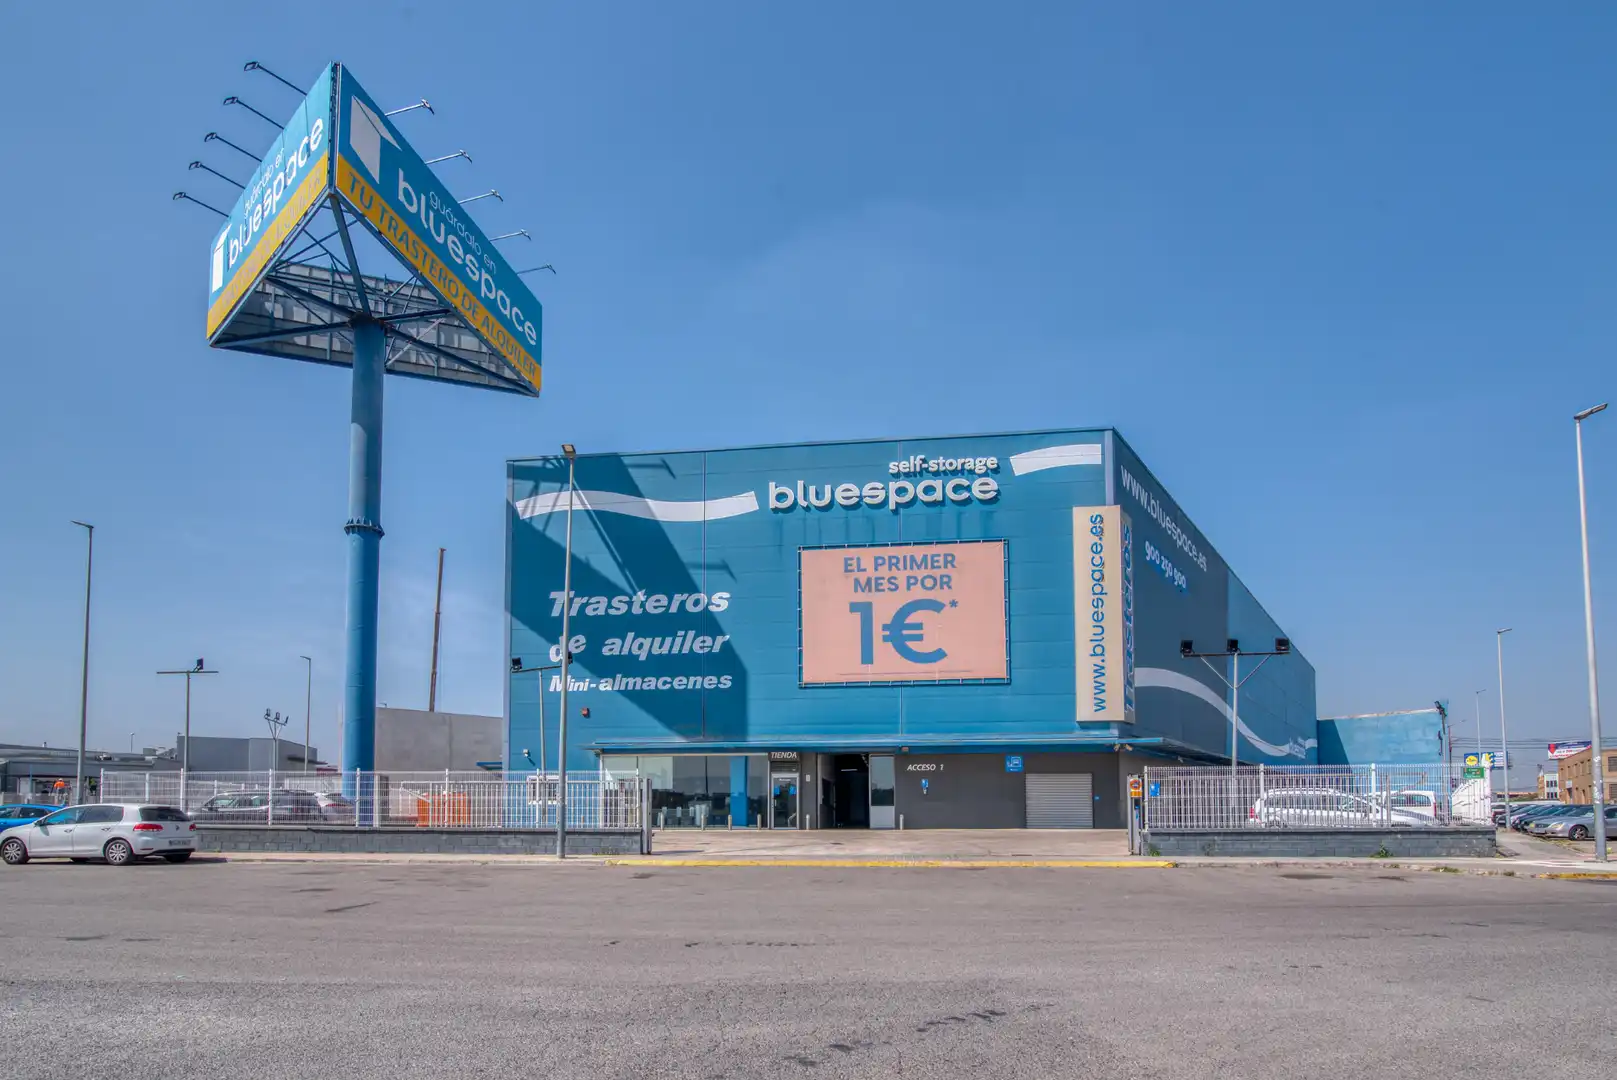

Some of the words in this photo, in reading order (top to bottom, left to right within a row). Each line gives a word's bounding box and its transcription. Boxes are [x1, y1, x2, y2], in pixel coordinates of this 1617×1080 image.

[228, 118, 324, 269] bluespace
[429, 191, 482, 255] guárdalo
[484, 254, 497, 275] en
[398, 168, 537, 346] bluespace
[349, 172, 374, 210] TU
[379, 202, 460, 299] TRASTERO
[460, 292, 481, 320] DE
[481, 315, 537, 377] ALQUILER
[888, 454, 999, 475] self-storage
[768, 476, 999, 511] bluespace
[1120, 465, 1208, 573] www.bluespace.es
[843, 556, 868, 573] EL
[873, 552, 957, 573] PRIMER
[1145, 540, 1160, 564] 900
[853, 575, 899, 593] MES
[906, 573, 953, 592] POR
[548, 589, 731, 617] Trasteros
[1089, 513, 1108, 713] www.bluespace.es
[549, 634, 587, 662] de
[602, 630, 730, 661] alquiler
[549, 673, 733, 692] Mini-almacenes
[770, 751, 798, 759] TIENDA
[906, 763, 937, 771] ACCESO
